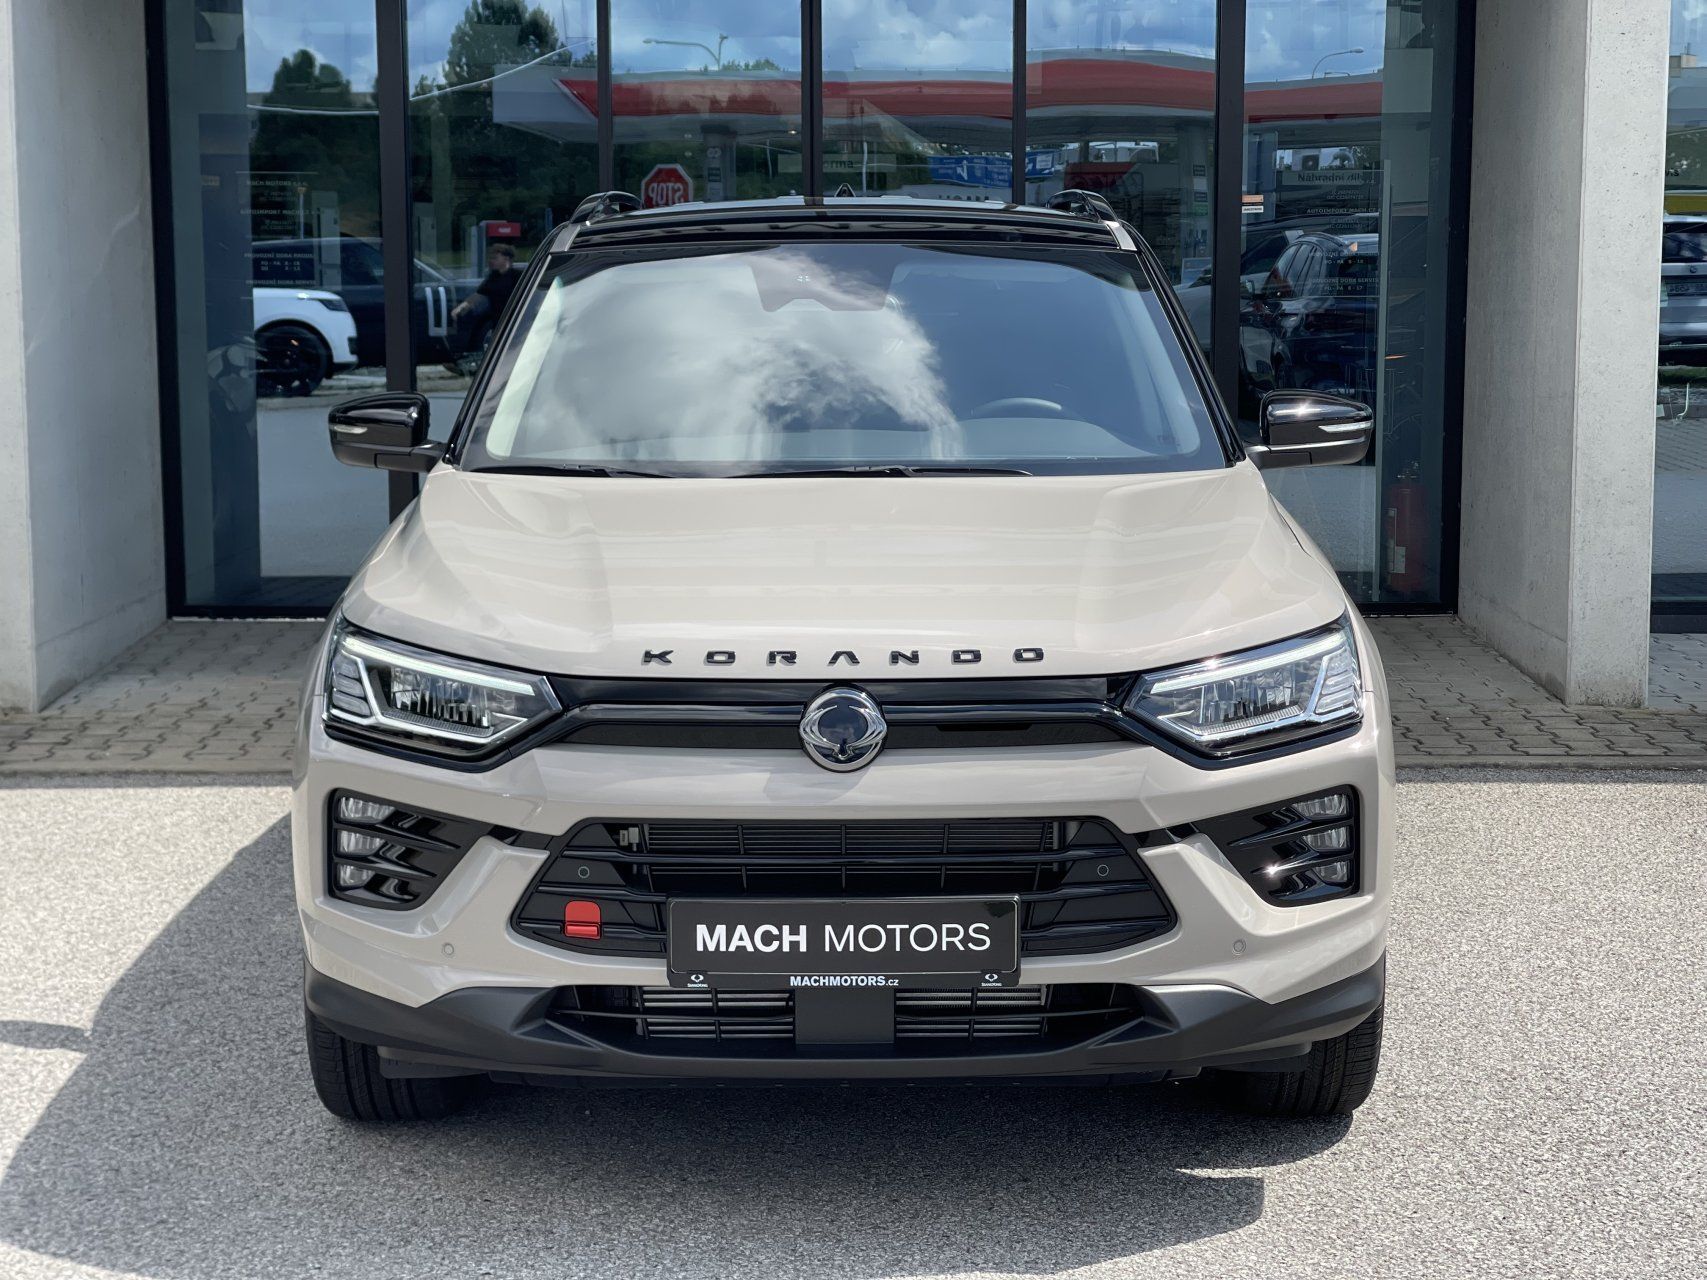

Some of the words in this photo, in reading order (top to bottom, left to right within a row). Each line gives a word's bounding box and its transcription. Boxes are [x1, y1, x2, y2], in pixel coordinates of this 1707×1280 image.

[641, 647, 1045, 665] KORANDO
[696, 924, 807, 952] MACH
[825, 922, 991, 952] MOTORS
[790, 975, 899, 987] MACHMOTORS.cz
